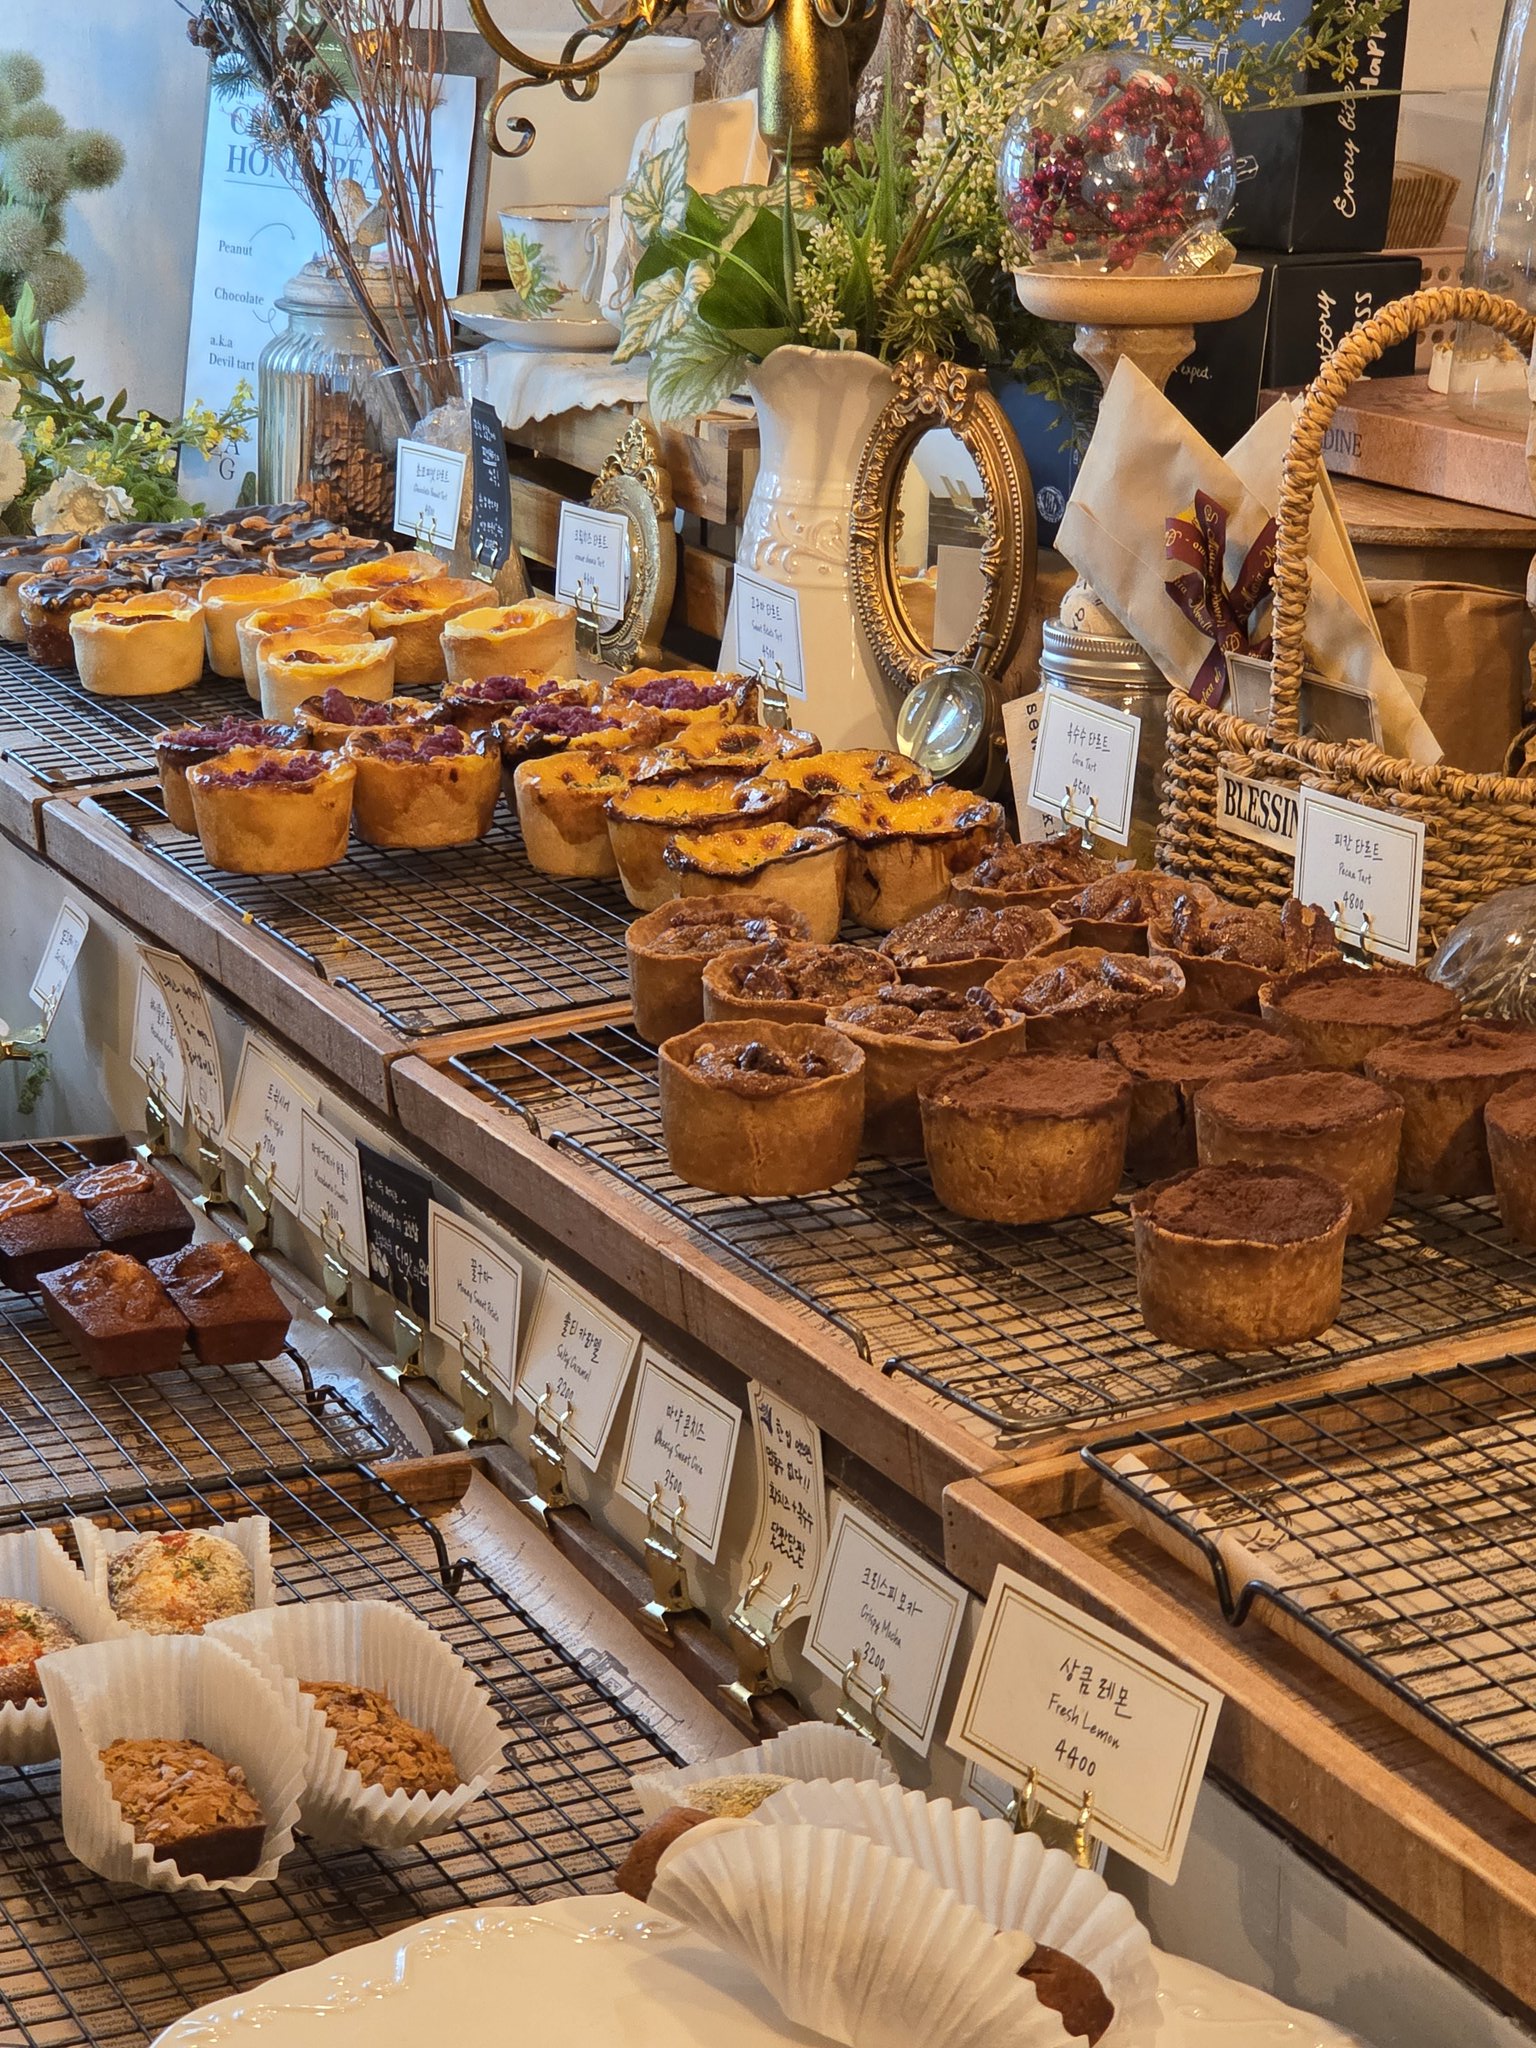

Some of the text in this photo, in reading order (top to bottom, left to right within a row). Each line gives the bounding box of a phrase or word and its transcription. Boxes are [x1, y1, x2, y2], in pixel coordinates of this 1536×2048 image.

[1332, 136, 1361, 219] Every
[218, 239, 253, 257] Peanut
[214, 286, 264, 306] Chocolate
[210, 334, 233, 348] a.k.a
[208, 352, 256, 371] Devil tart
[1320, 429, 1362, 458] DINE
[1067, 722, 1111, 752] 옥수수 타르트
[1072, 752, 1097, 773] Corn Tart
[1073, 777, 1090, 796] 4500
[1223, 776, 1299, 839] BLESSIN
[1335, 834, 1383, 861] 피칸 타르트
[1338, 861, 1371, 885] Pecan Tart
[1343, 891, 1364, 910] 4800
[557, 1344, 571, 1369] Salty
[556, 1377, 575, 1401] 3200
[665, 1405, 706, 1441] 마약 콘치즈
[674, 1443, 691, 1466] Sweet
[664, 1468, 682, 1494] 3500
[770, 1521, 807, 1570] 단짠단짠
[861, 1567, 923, 1617] 크리스피 모카
[860, 1603, 902, 1649] Crispy Mocha
[862, 1641, 886, 1672] 3200
[1059, 1656, 1132, 1720] 상큼 레몬
[1047, 1692, 1120, 1750] Fresh Lemon
[1054, 1738, 1097, 1777] 4400
